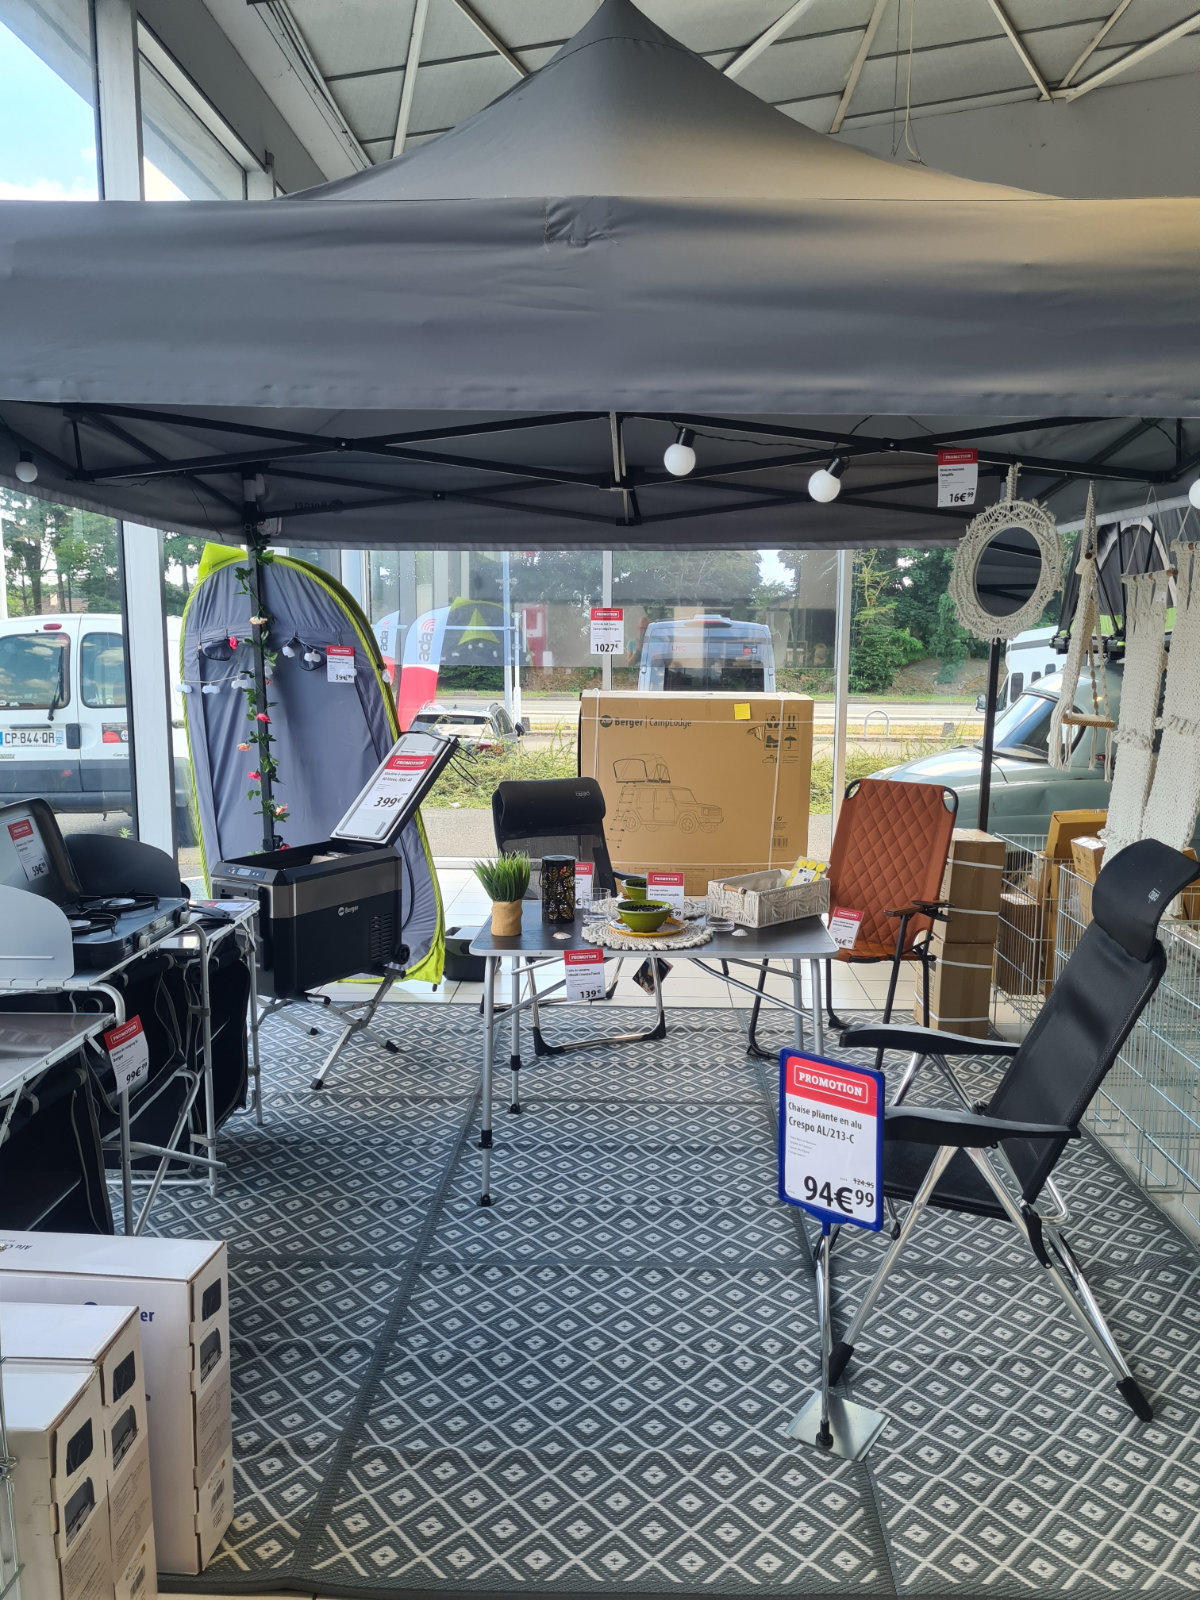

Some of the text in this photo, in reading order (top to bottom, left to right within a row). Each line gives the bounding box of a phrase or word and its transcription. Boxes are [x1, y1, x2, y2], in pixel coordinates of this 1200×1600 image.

[418, 632, 434, 662] ada
[615, 717, 691, 729] Berger CampLodge
[798, 1071, 863, 1097] PROMOTION
[788, 1101, 863, 1130] Chaise pliante en alu
[788, 1116, 855, 1144] Crespo AL/213-C
